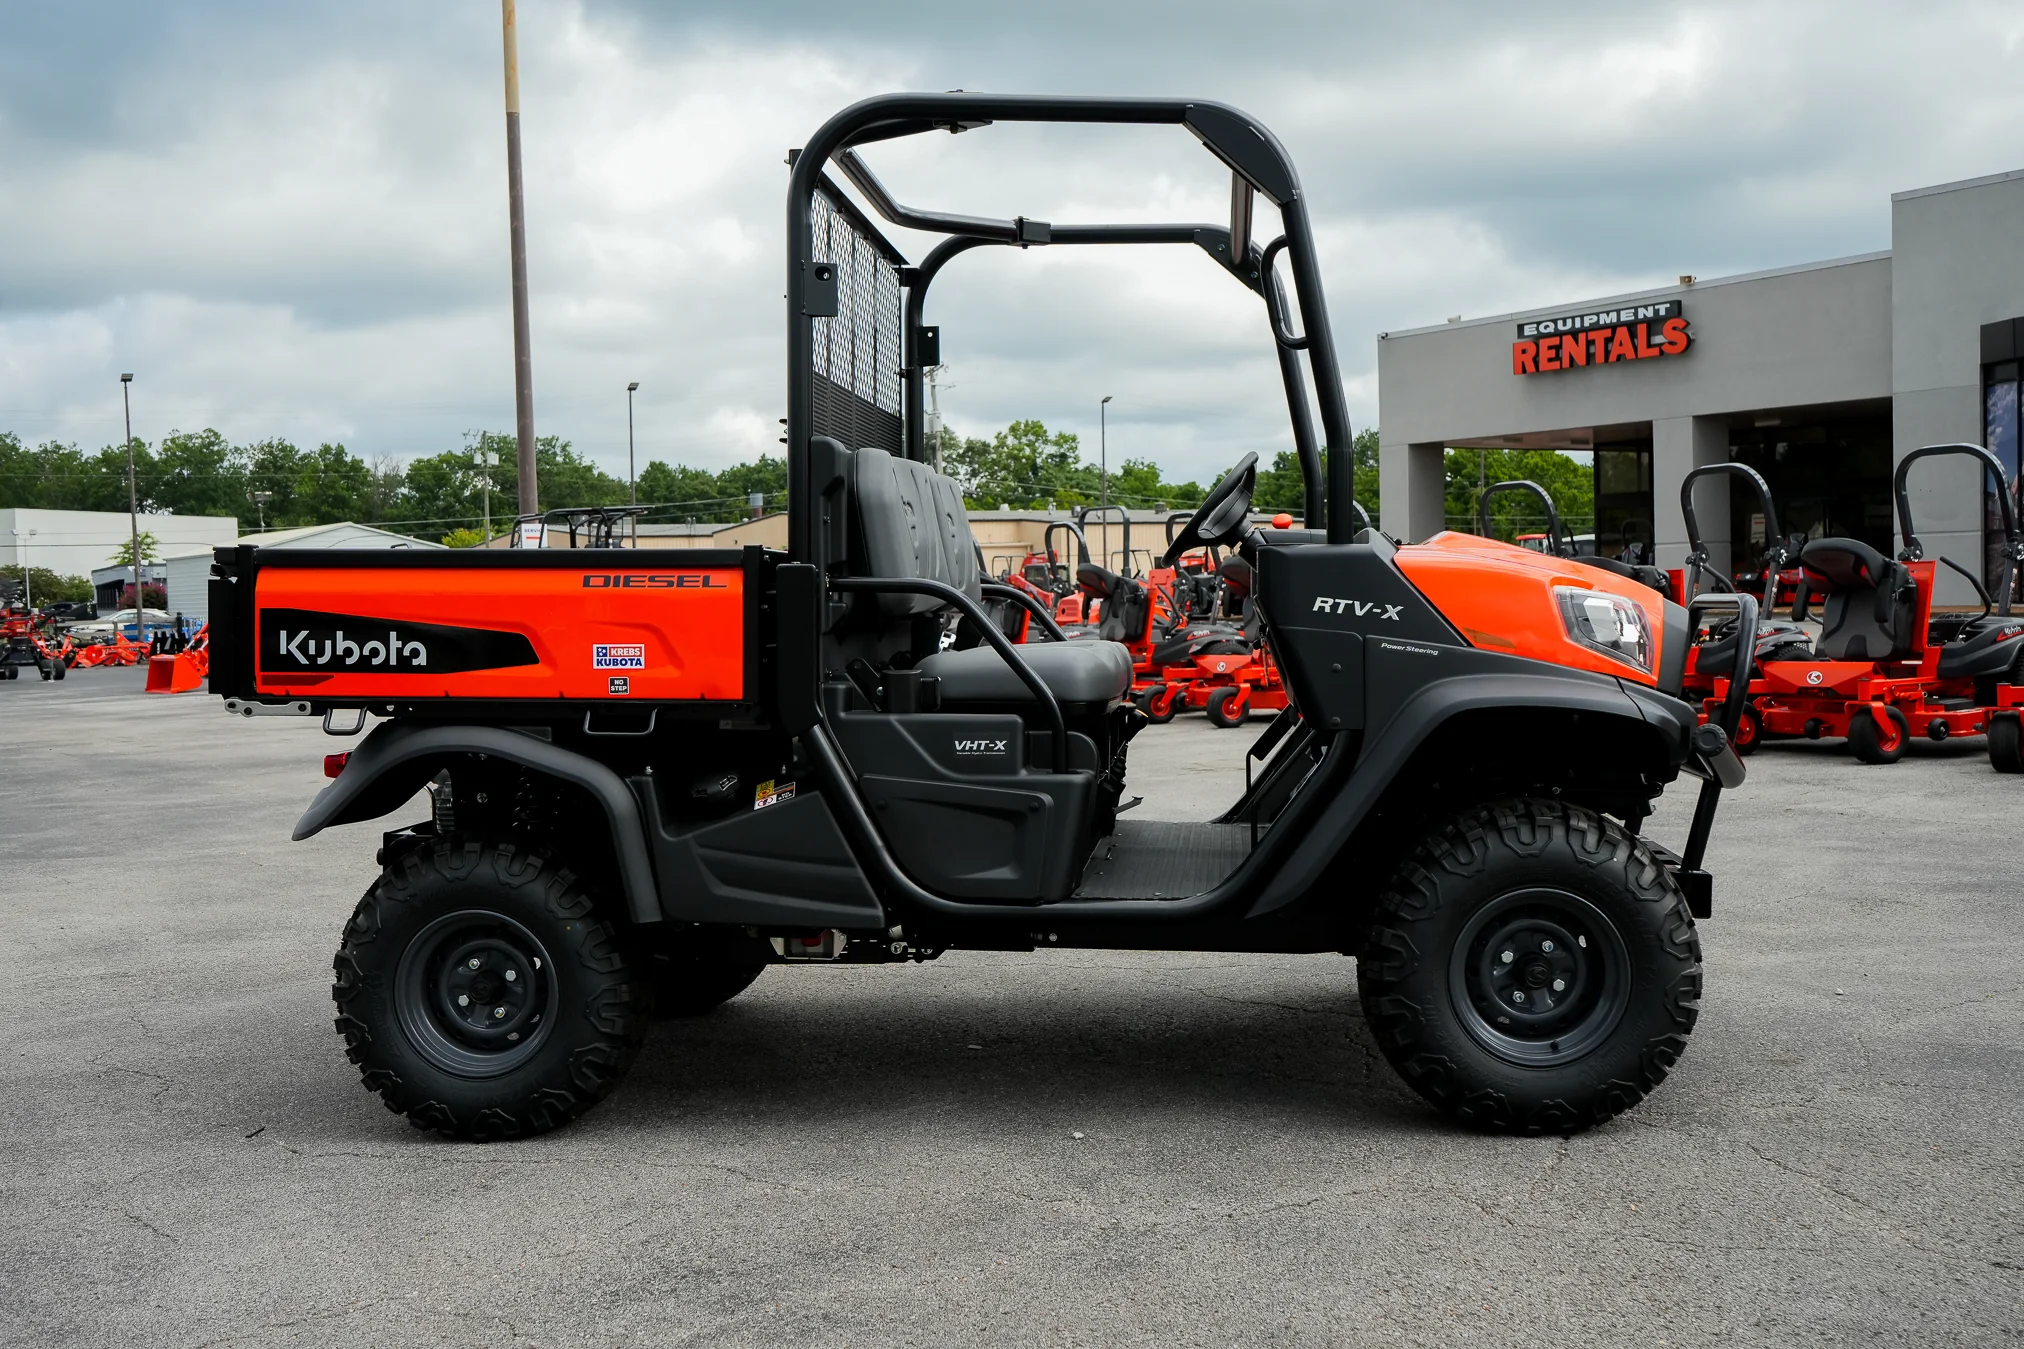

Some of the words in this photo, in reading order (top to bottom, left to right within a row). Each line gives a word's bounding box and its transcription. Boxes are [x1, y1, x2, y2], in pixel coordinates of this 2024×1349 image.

[1523, 303, 1670, 336] EQUIPMENT
[1513, 317, 1688, 375] RENTALS
[582, 574, 727, 588] DIESEL
[1312, 596, 1404, 621] RTV-X
[279, 630, 427, 666] Kubota
[610, 647, 641, 656] KREBS
[1381, 642, 1406, 651] Power
[1406, 645, 1439, 656] Steering
[596, 658, 643, 667] KUBOTA
[954, 740, 1008, 751] VHT-X
